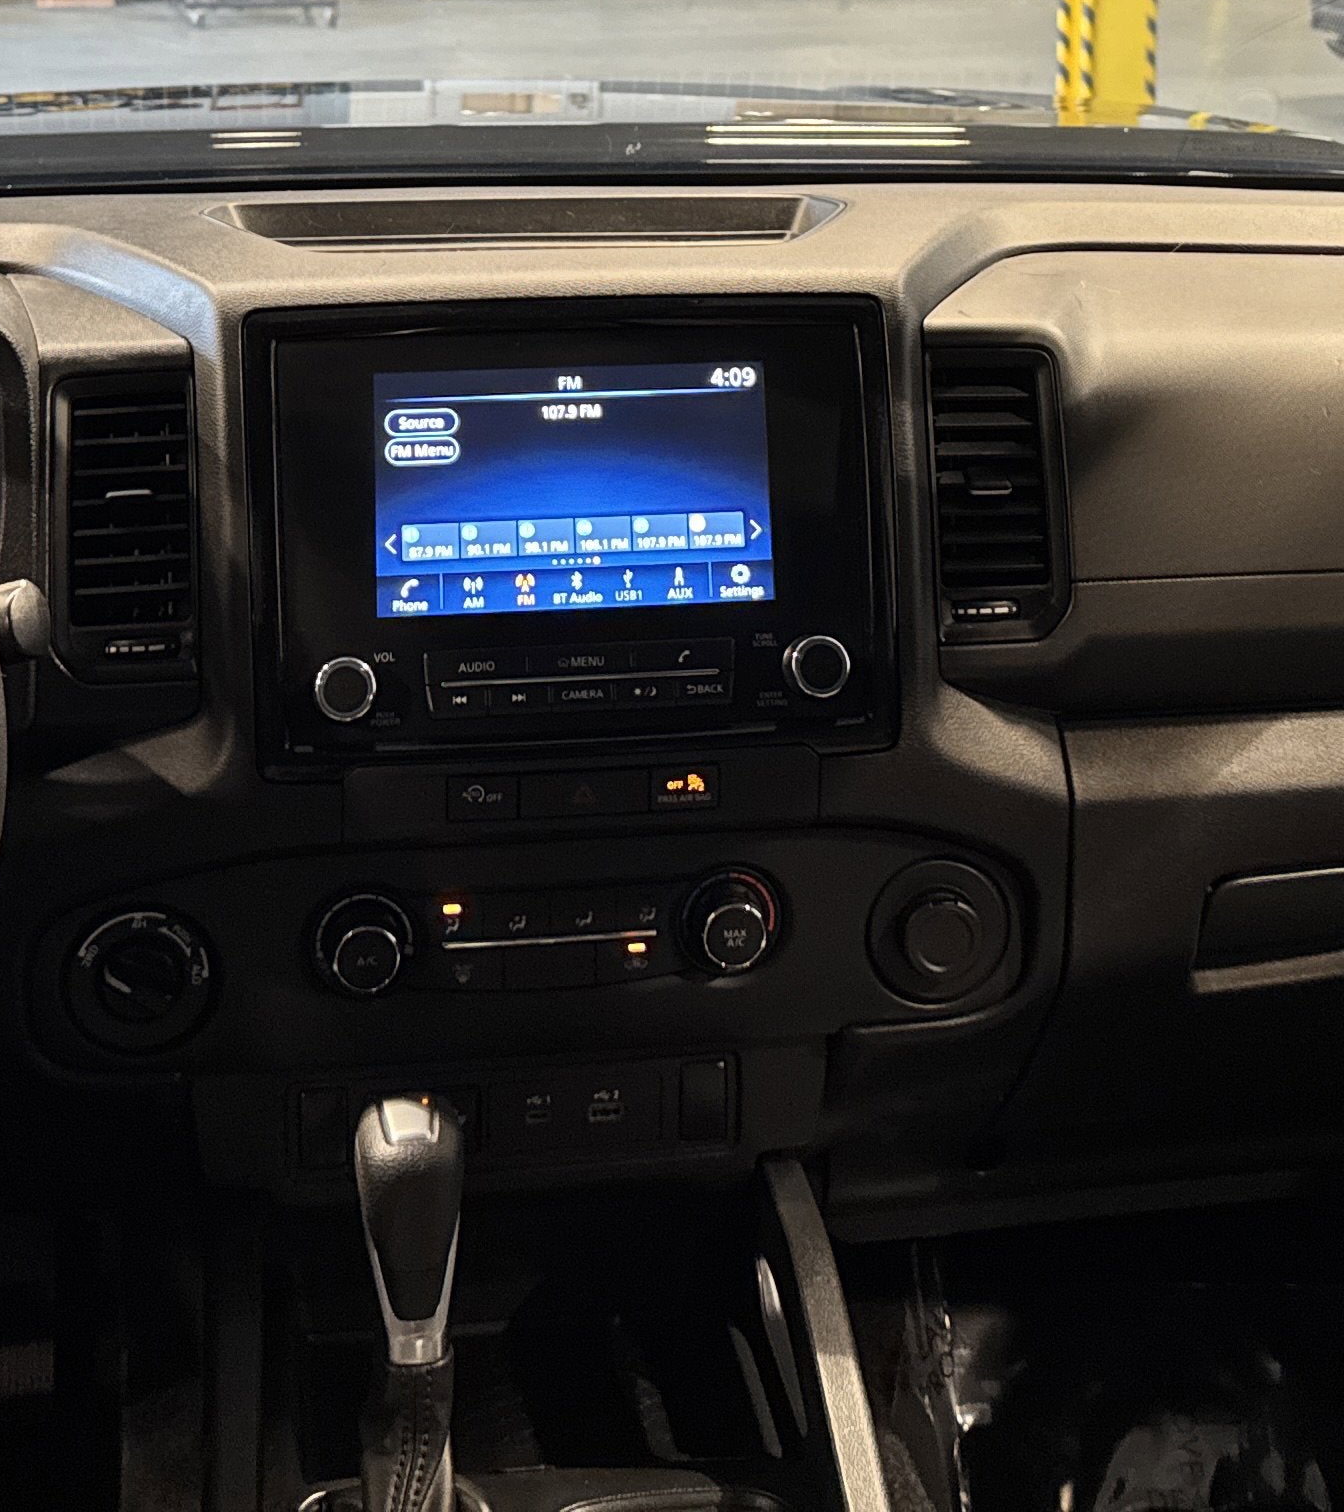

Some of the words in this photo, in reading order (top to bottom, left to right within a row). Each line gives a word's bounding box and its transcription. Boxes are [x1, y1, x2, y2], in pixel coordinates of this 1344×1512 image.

[556, 375, 583, 391] FM
[709, 366, 756, 388] 4:09
[541, 404, 577, 421] 107.9
[579, 403, 602, 419] FM
[397, 414, 445, 431] Source
[389, 444, 411, 459] FM
[413, 442, 454, 458] Menu
[550, 540, 569, 553] FM
[611, 537, 629, 550] FM
[636, 536, 666, 549] 107.9
[667, 535, 686, 548] FM
[693, 534, 723, 547] 107.9
[724, 533, 743, 546] FM
[408, 545, 434, 559] 87.9
[435, 544, 454, 557] FM
[493, 542, 511, 555] FM
[516, 593, 536, 606] FM
[552, 592, 568, 605] BT
[569, 590, 604, 604] Audio
[614, 589, 643, 602] USB1
[666, 587, 694, 600] AUX
[719, 585, 766, 602] Settings
[392, 600, 429, 612] Phone
[462, 596, 485, 609] AM
[373, 651, 396, 663] VOL
[570, 655, 605, 667] MENU
[457, 660, 496, 674] AUDIO
[561, 689, 605, 701] CAMERA
[697, 684, 723, 694] BACK
[666, 779, 684, 790] OFF
[723, 928, 747, 939] MAX
[726, 938, 746, 948] A/C
[355, 955, 379, 967] A/C
